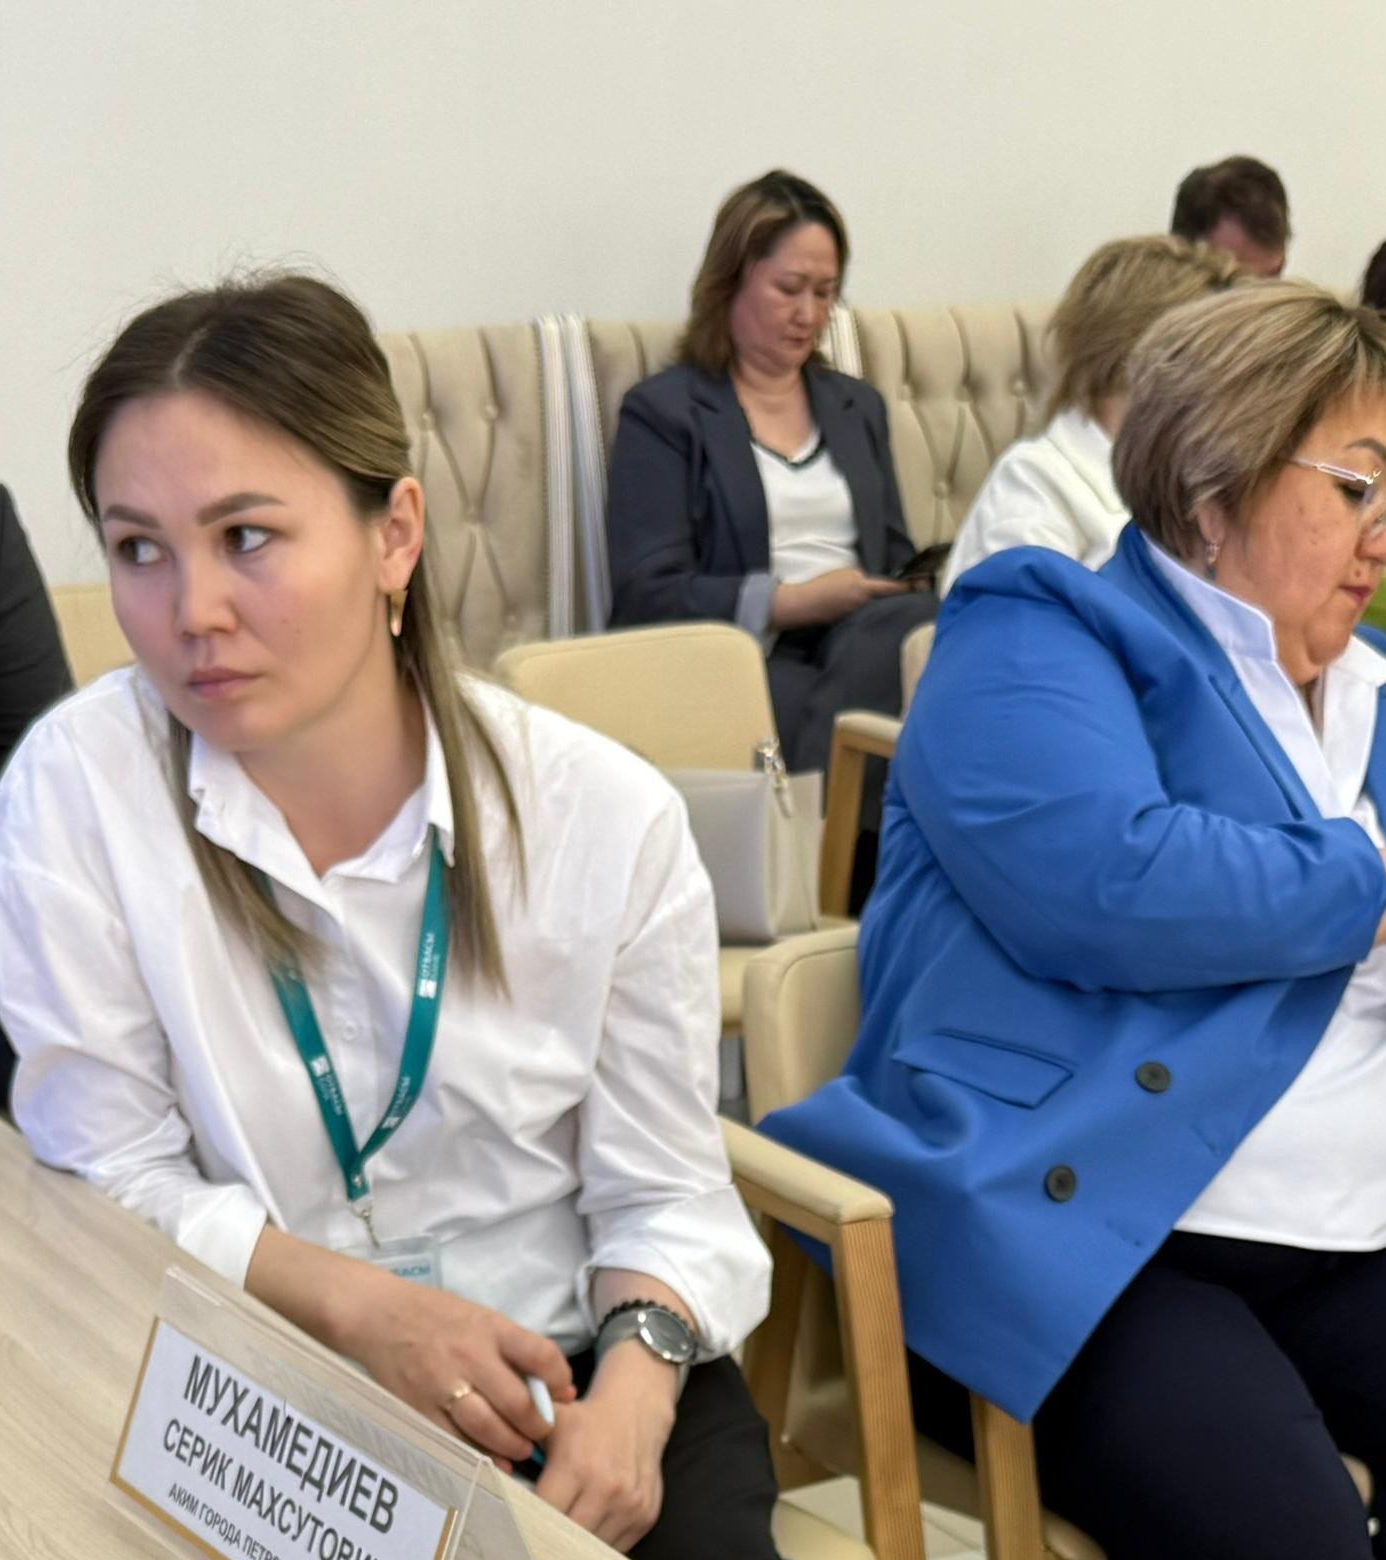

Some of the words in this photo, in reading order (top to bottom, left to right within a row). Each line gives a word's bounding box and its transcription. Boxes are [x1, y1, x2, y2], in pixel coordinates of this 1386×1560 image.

[163, 1418, 232, 1491] СЕРИК
[183, 1355, 399, 1534] МУХАМЕДИЕВ
[168, 1482, 200, 1515] АКИМ
[198, 1499, 242, 1549] ГОРОДА
